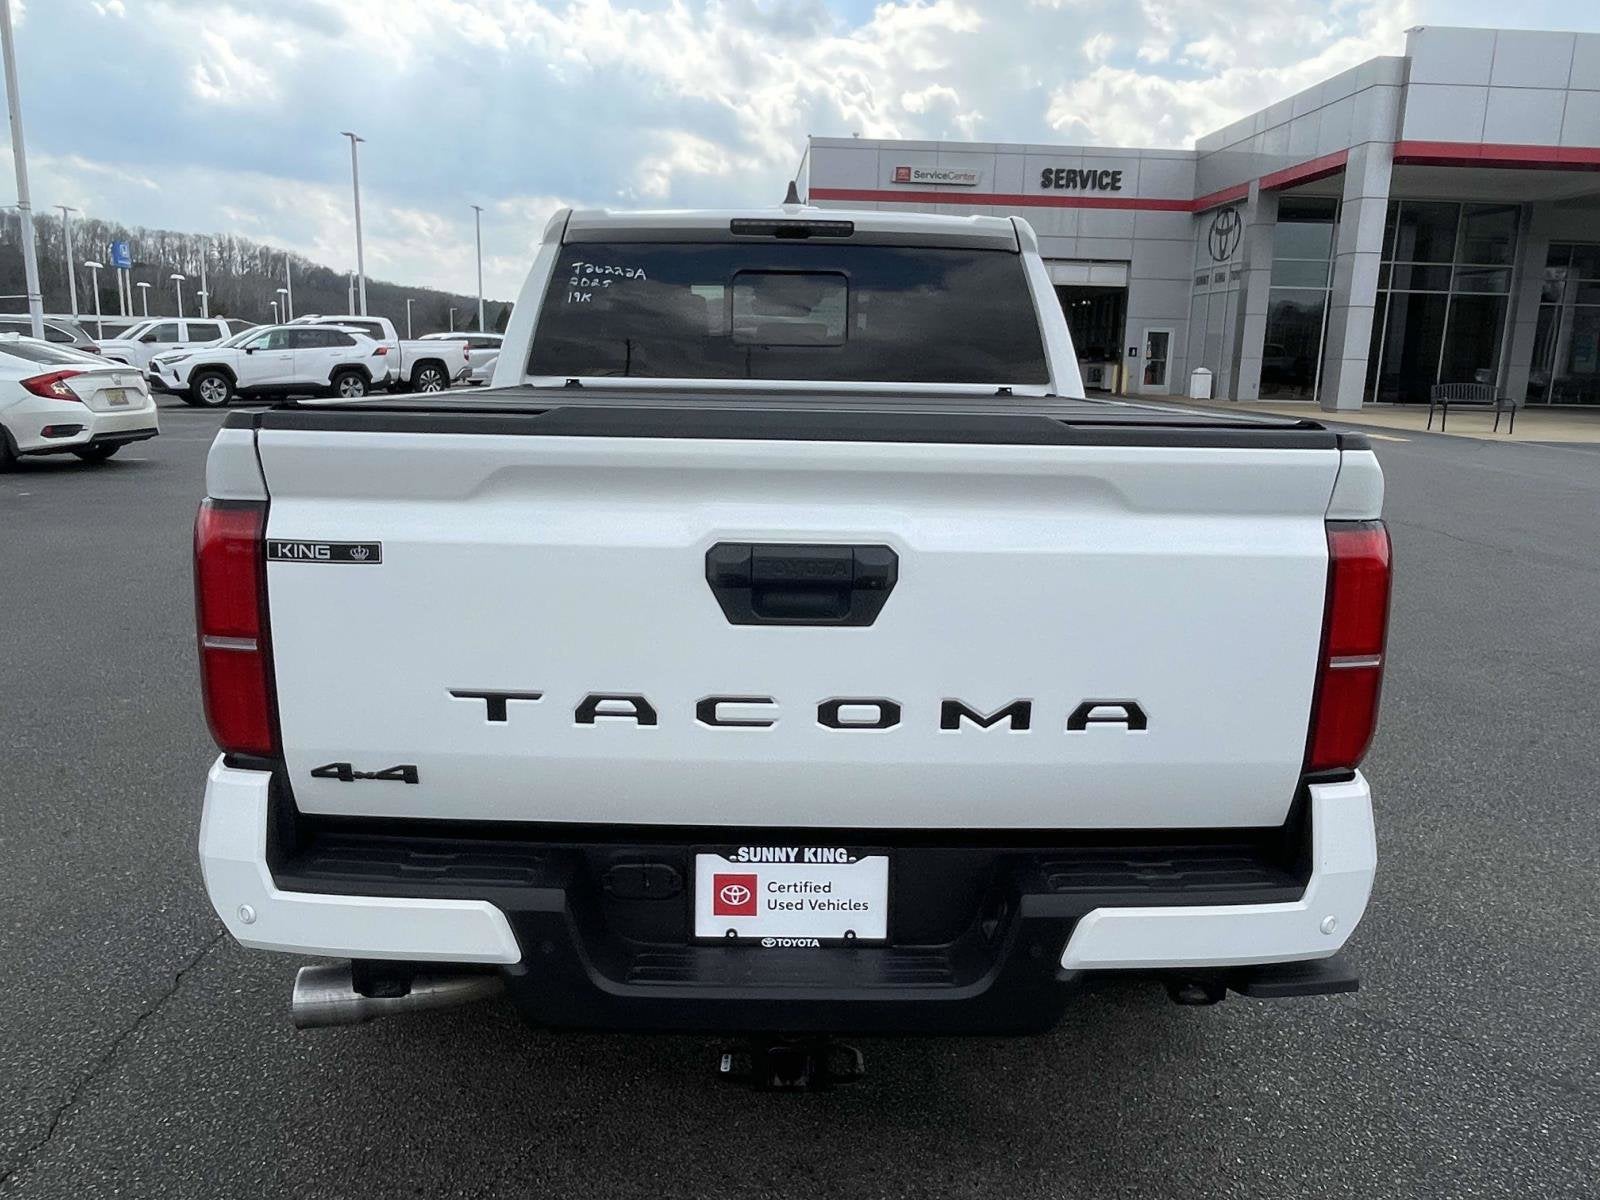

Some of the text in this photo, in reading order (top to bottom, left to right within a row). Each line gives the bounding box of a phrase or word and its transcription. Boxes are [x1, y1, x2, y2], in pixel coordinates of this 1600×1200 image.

[1041, 168, 1122, 191] SERVICE
[568, 292, 592, 303] 19K
[278, 543, 331, 559] KING
[448, 690, 1148, 731] TACOMA
[737, 847, 848, 863] SUNNY KING
[767, 881, 832, 893] Certified
[767, 899, 869, 911] Used Vehicles
[776, 938, 820, 947] TOYOTA
